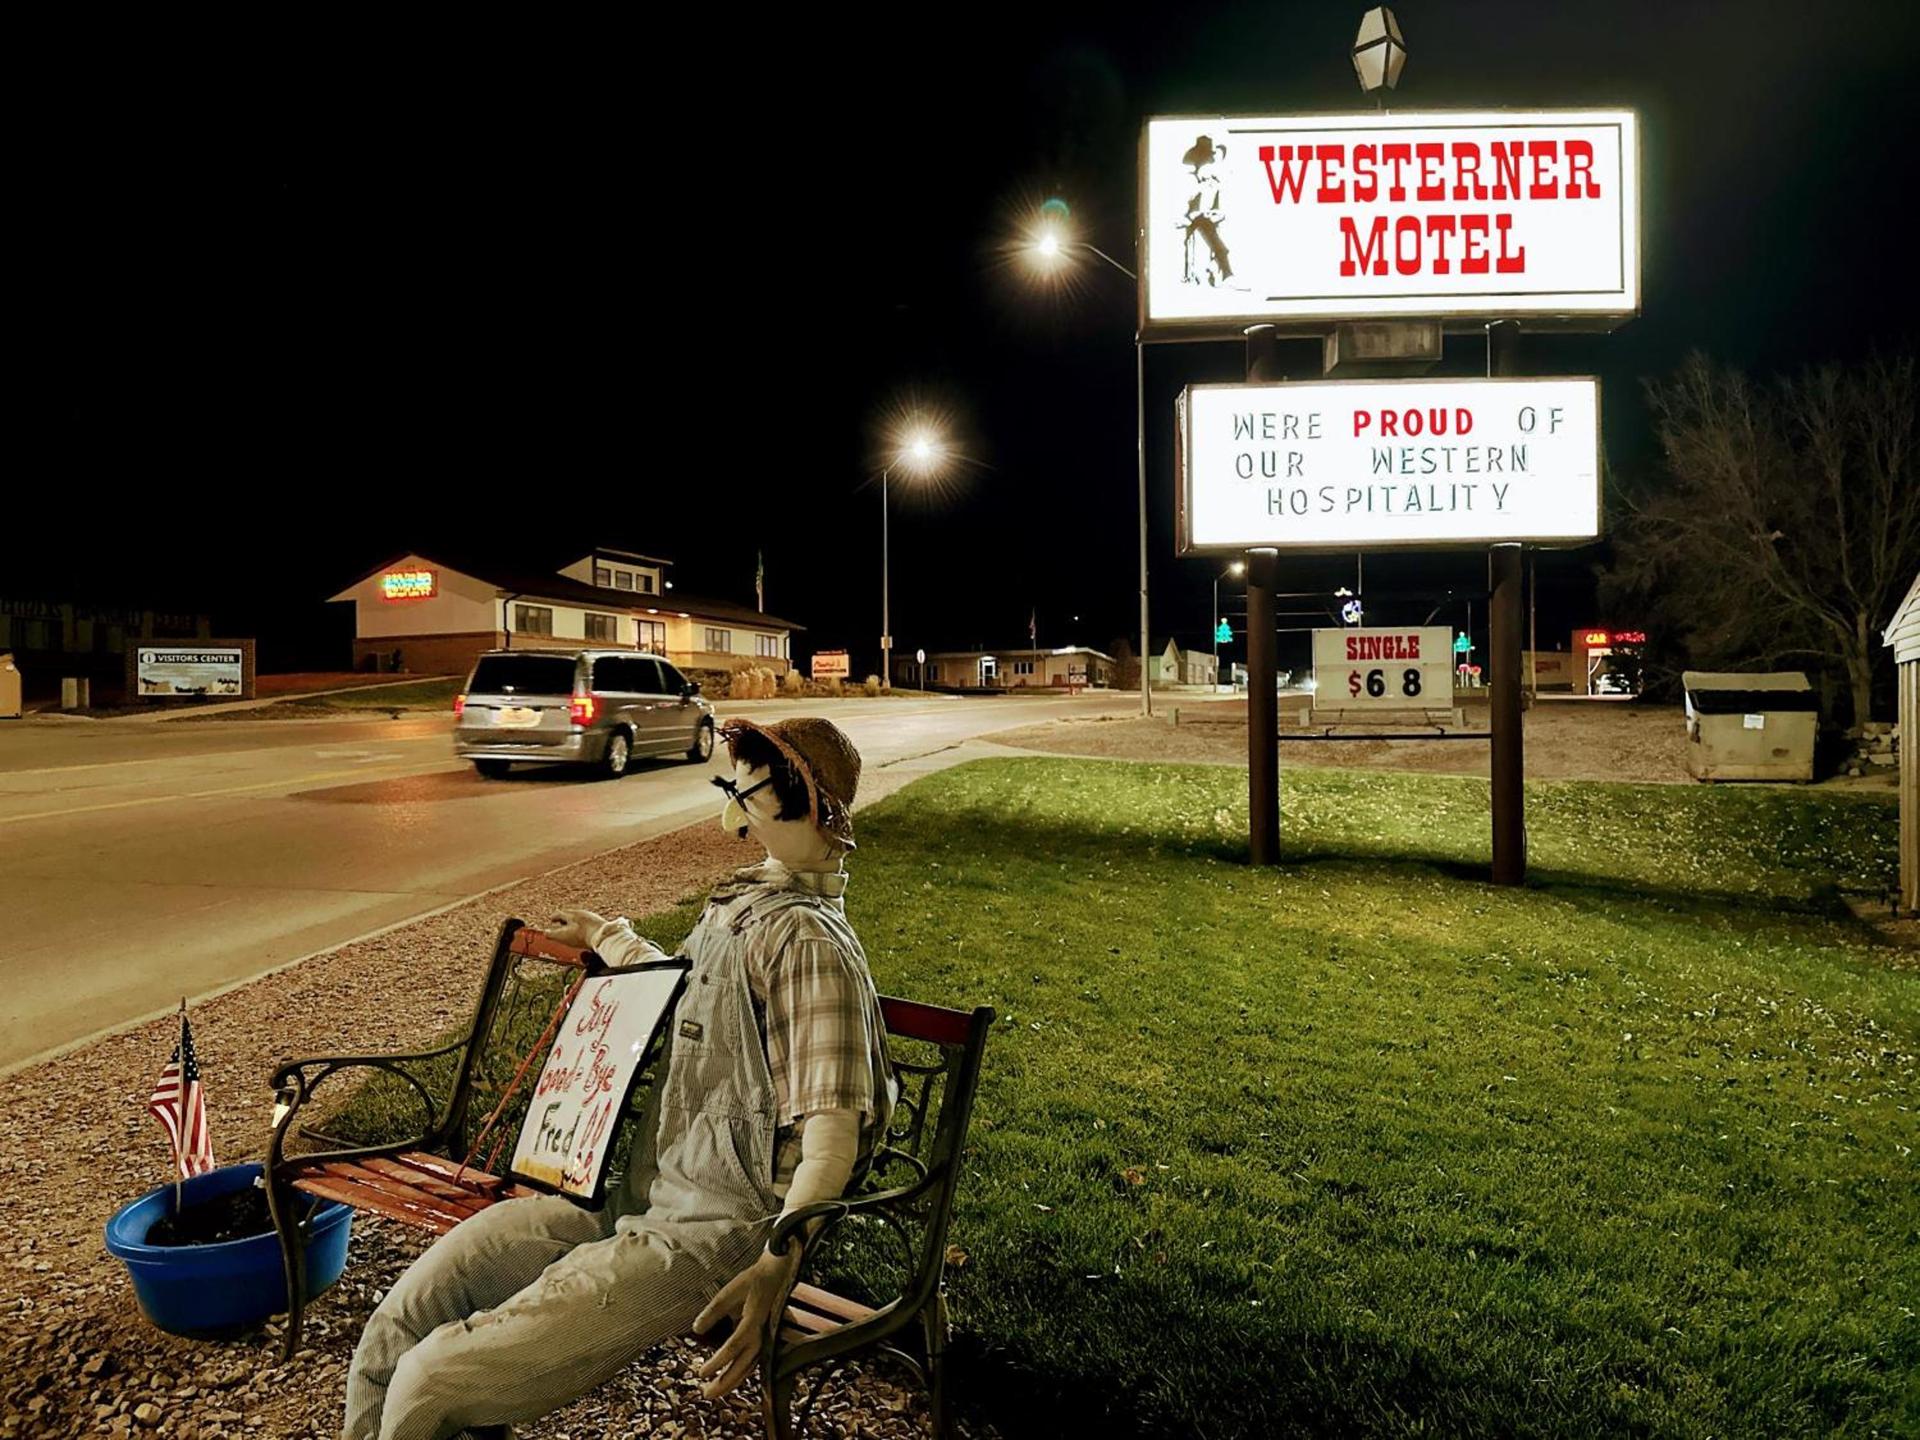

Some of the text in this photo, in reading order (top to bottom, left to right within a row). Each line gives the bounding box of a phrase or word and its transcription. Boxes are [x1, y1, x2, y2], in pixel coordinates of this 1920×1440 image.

[1259, 139, 1600, 204] WESTERNER
[1340, 213, 1525, 277] MOTEL
[1233, 406, 1564, 441] WERE PROUD OF
[1235, 444, 1529, 480] OUR WESTERN
[1267, 483, 1511, 515] HOSPITALITY
[157, 655, 234, 663] VISITORS CENTER
[1346, 635, 1420, 660] SINGLE
[576, 979, 620, 1052] Say
